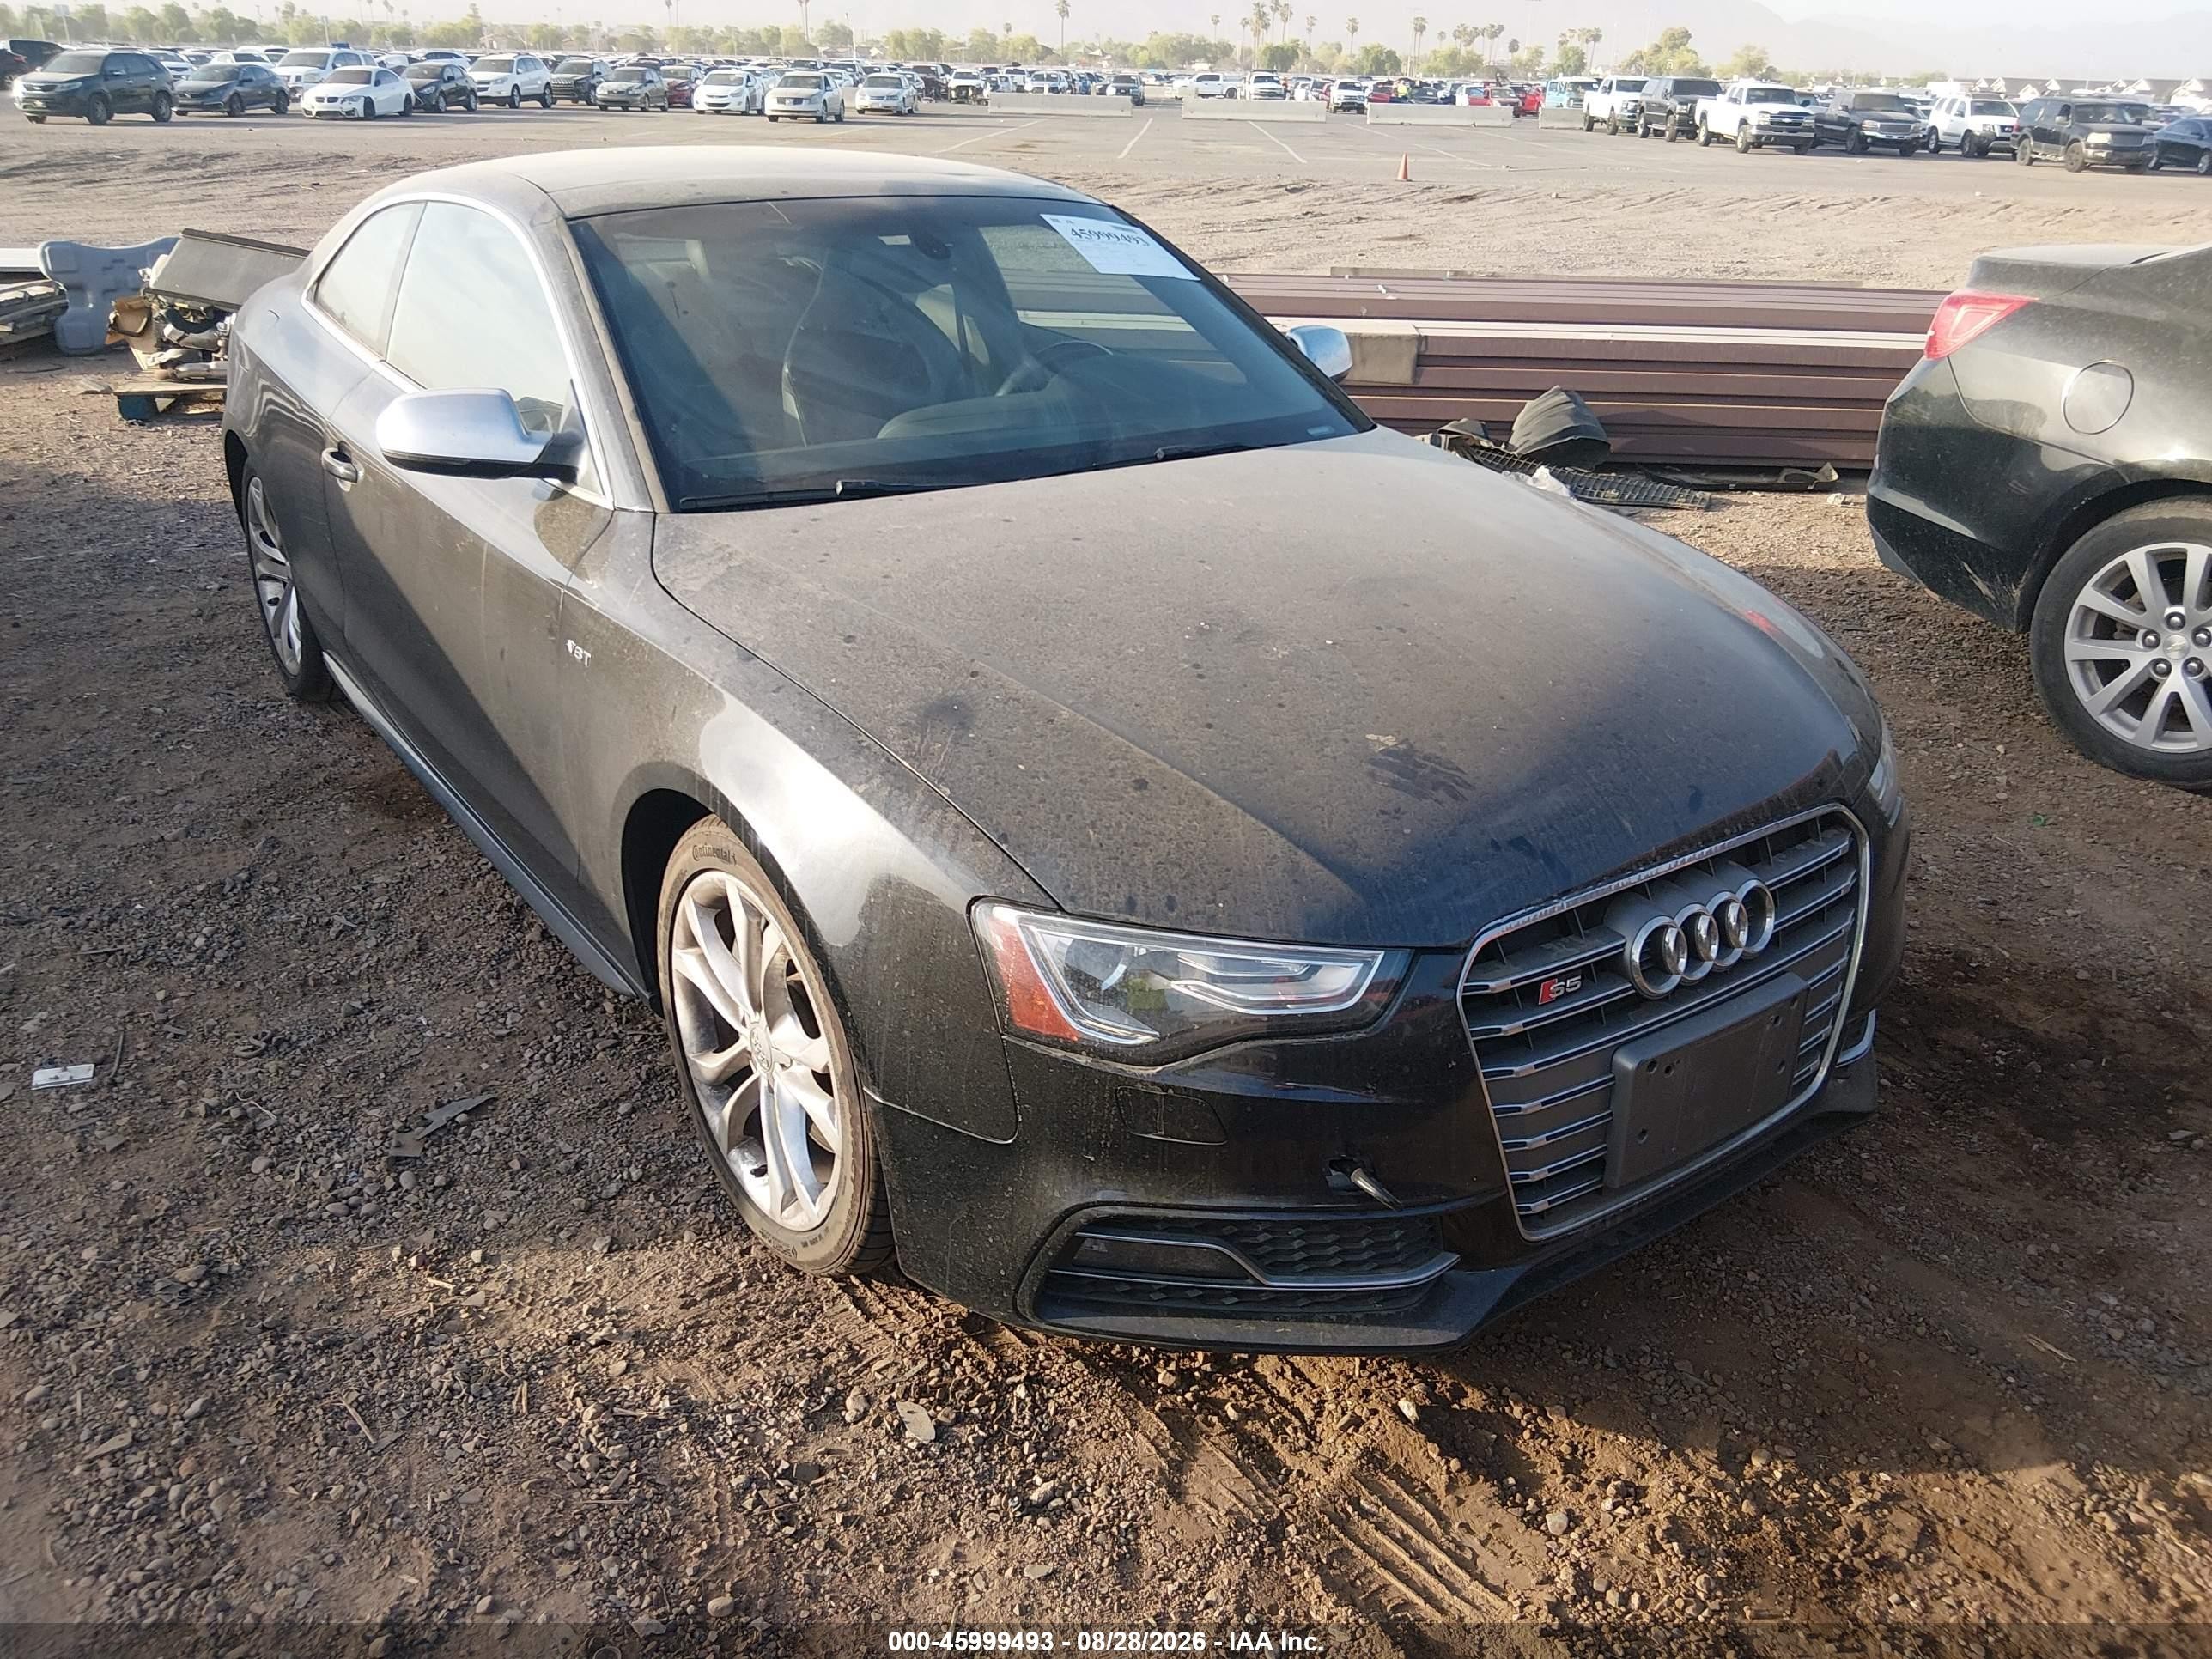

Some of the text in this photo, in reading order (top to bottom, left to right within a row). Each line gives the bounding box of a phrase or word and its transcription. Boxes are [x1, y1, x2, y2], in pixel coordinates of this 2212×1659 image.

[1070, 227, 1151, 247] 45999493
[692, 843, 731, 864] Continental
[1547, 975, 1583, 999] S5
